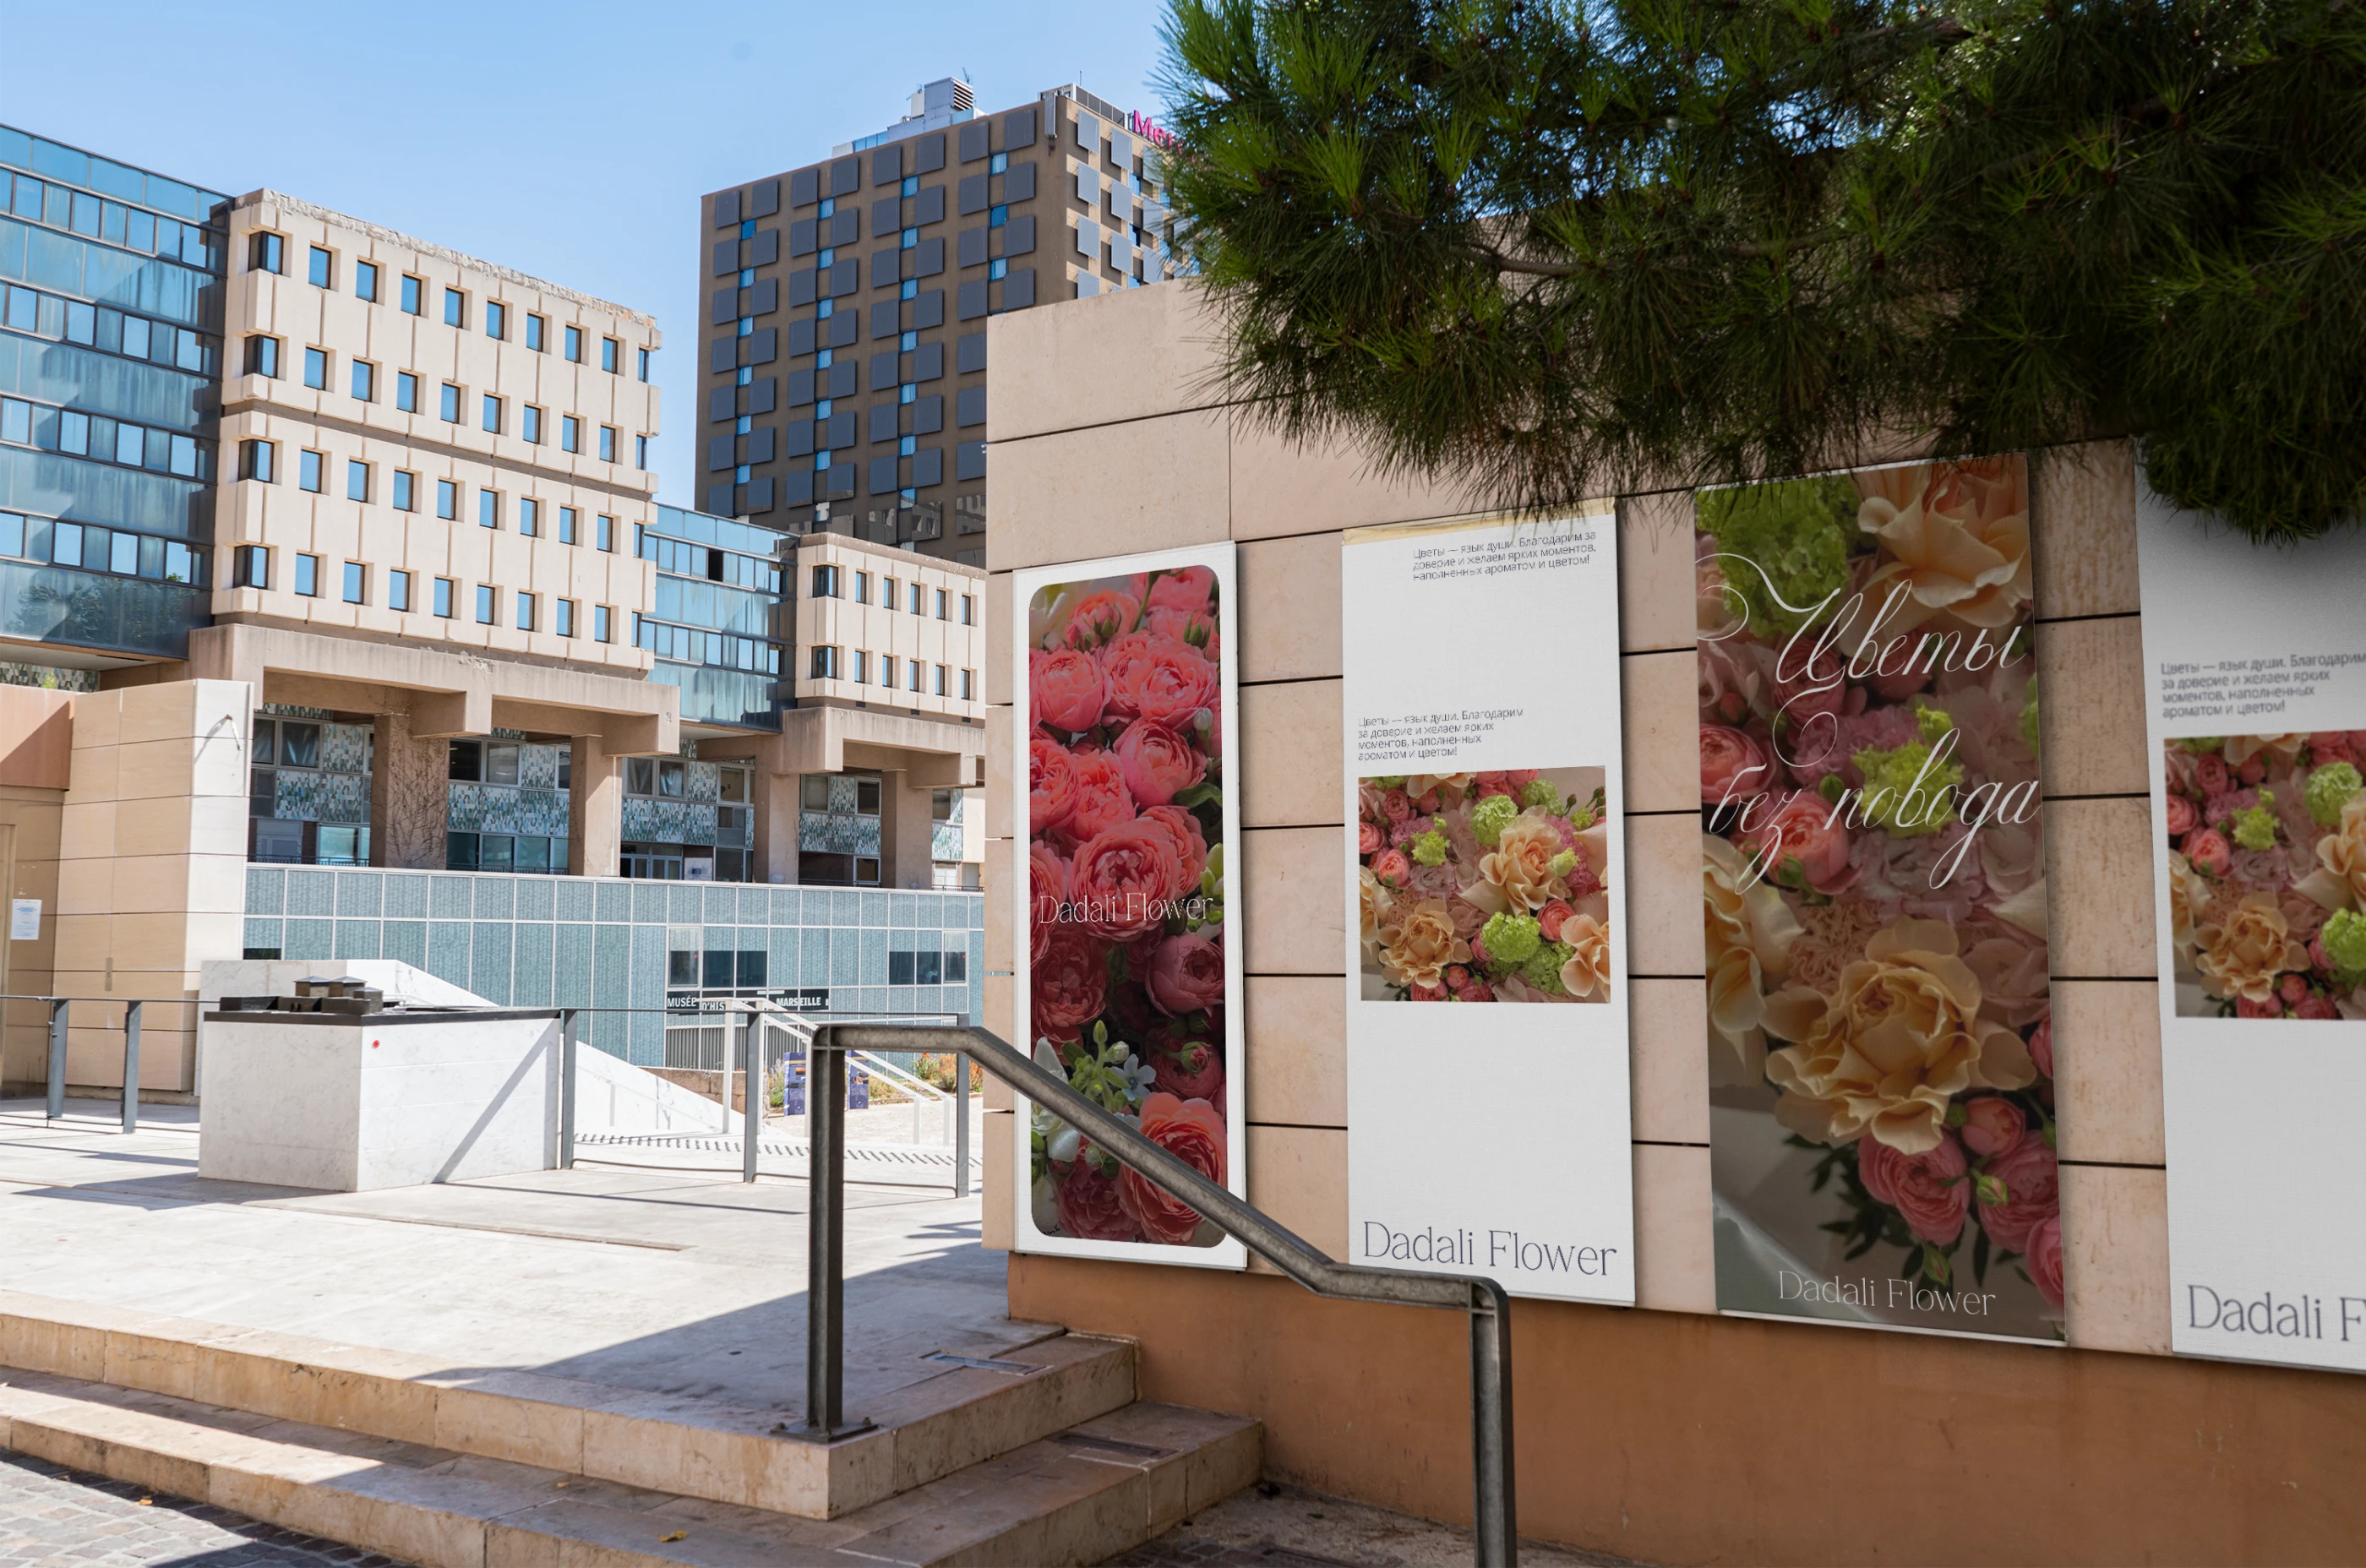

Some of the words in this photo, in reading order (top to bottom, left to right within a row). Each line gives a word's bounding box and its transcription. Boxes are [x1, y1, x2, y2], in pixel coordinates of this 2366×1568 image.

[1413, 548, 1445, 559] Цветы
[1461, 543, 1485, 554] язык
[1487, 541, 1516, 553] души.
[1519, 533, 1583, 548] Благодарим
[1584, 531, 1597, 541] за
[1413, 558, 1456, 572] доверие
[1458, 557, 1465, 565] и
[1468, 553, 1507, 564] желаем
[1508, 549, 1538, 563] ярких
[1413, 567, 1482, 581] наполненных
[1485, 562, 1536, 576] ароматом
[1539, 560, 1546, 569] и
[1548, 554, 1590, 569] цветом!
[2160, 662, 2200, 676] Цветы
[2219, 661, 2248, 672] язык
[2250, 657, 2287, 672] души.
[2290, 651, 2366, 668] Благодарим
[2162, 678, 2175, 690] за
[2177, 675, 2229, 690] доверие
[2232, 675, 2241, 685] и
[2243, 672, 2290, 685] желаем
[2293, 669, 2331, 685] ярких
[2162, 690, 2226, 703] моментов,
[2228, 685, 2315, 700] наполненных
[1359, 716, 1389, 728] Цветы
[1404, 715, 1427, 725] язык
[1430, 713, 1459, 725] души.
[1462, 708, 1524, 721] Благодарим
[2162, 705, 2223, 720] ароматом
[2225, 704, 2233, 715] и
[2237, 700, 2286, 716] цветом!
[1358, 730, 1369, 738] за
[1371, 727, 1413, 739] доверие
[1415, 727, 1422, 735] и
[1424, 724, 1462, 735] желаем
[1464, 722, 1494, 733] ярких
[1358, 739, 1410, 750] моментов,
[1412, 734, 1481, 747] наполненных
[1358, 749, 1407, 762] ароматом
[1409, 749, 1415, 759] и
[1418, 746, 1458, 760] цветом!
[1709, 763, 1802, 895] без
[1824, 728, 2042, 890] повода
[1039, 894, 1116, 924] Dadali
[1126, 892, 1213, 922] Flower
[667, 995, 697, 1008] MUSÉE
[776, 996, 822, 1007] MARSEILLE
[1363, 1221, 1475, 1266] Dadali
[1488, 1229, 1617, 1276] Flower
[1778, 1270, 1876, 1307] Dadali
[1887, 1277, 1997, 1315] Flower
[2187, 1284, 2322, 1339] Dadali
